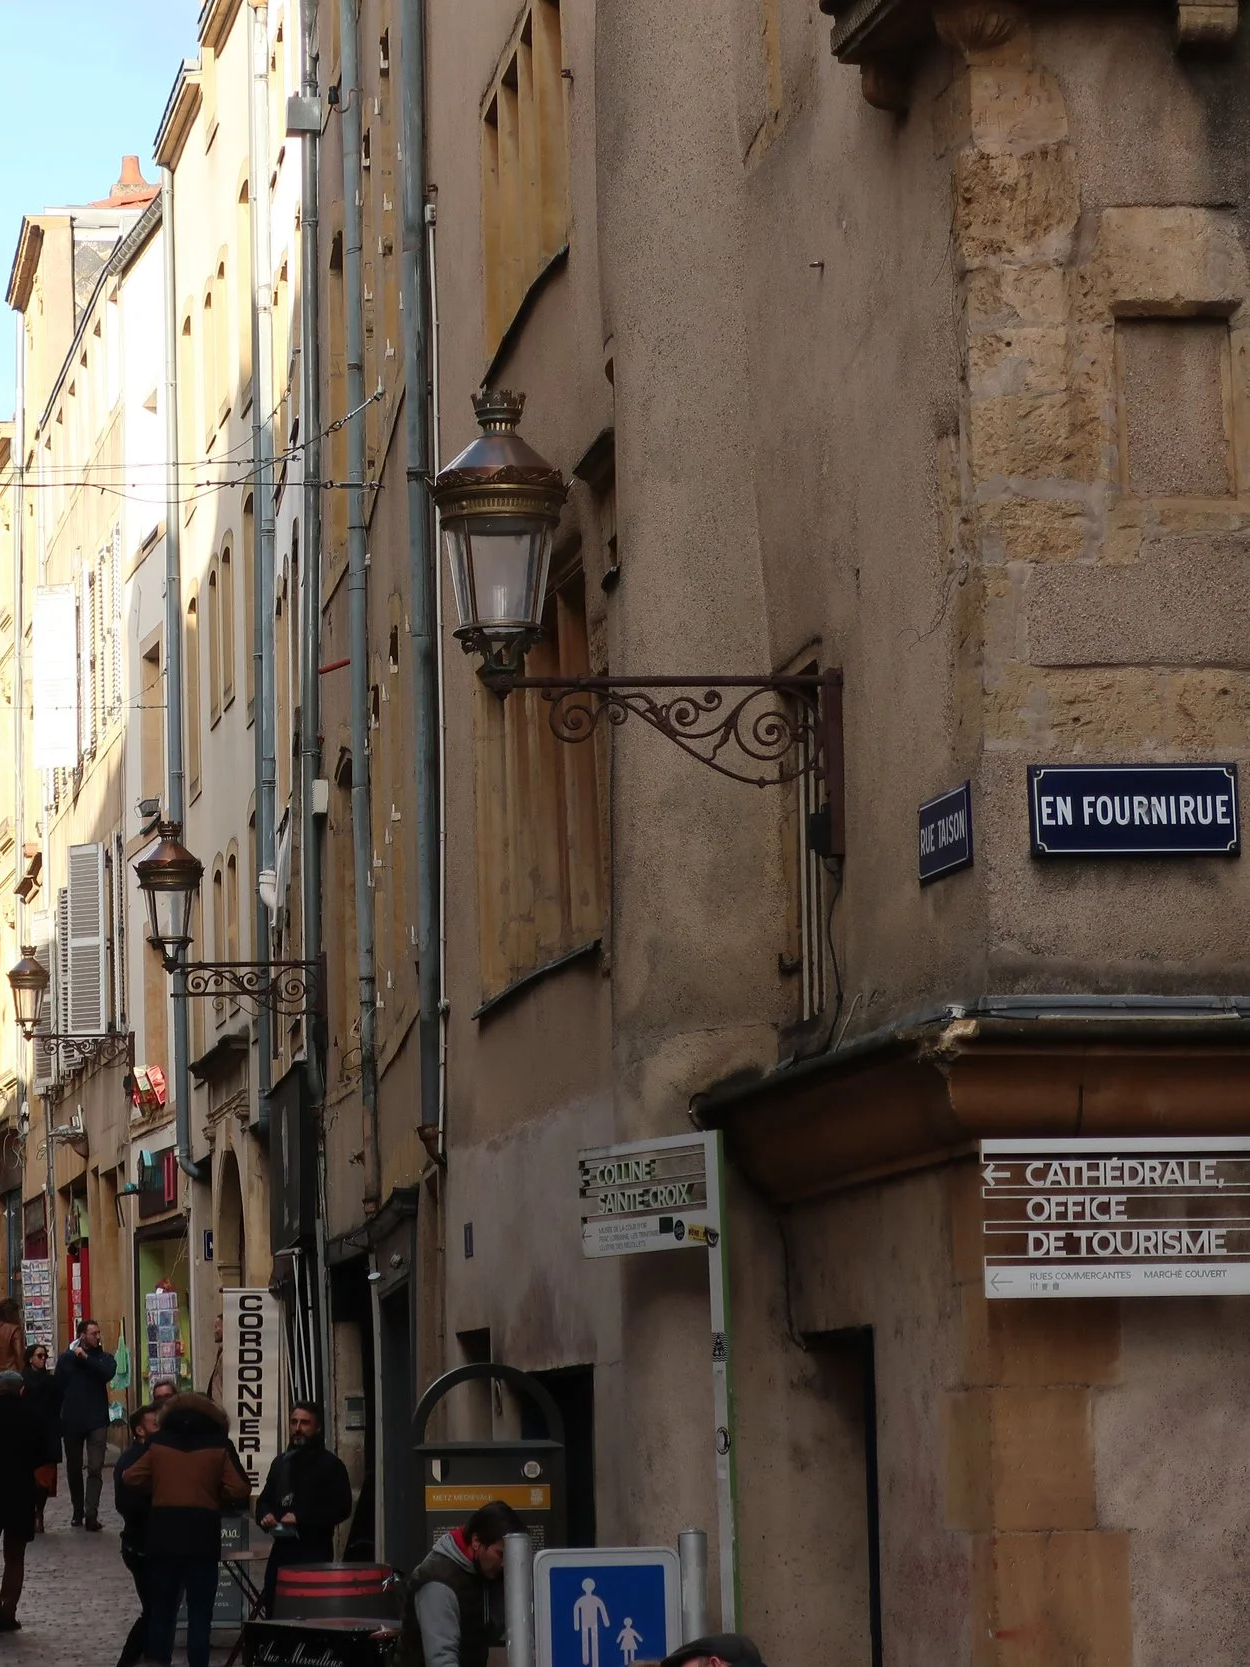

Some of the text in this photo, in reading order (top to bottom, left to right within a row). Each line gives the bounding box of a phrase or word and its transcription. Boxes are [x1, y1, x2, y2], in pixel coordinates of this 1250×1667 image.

[1040, 795, 1231, 826] EN FOURNIRUE
[920, 808, 966, 857] RUE TAISON
[596, 1160, 651, 1185] COLLINE
[1025, 1157, 1225, 1189] CATHÉDRALE,
[599, 1183, 688, 1214] SAINTE-CROIX
[1026, 1196, 1128, 1222] OFFICE
[1027, 1229, 1228, 1257] DE TOURISME
[1030, 1272, 1053, 1281] RUES
[1185, 1269, 1227, 1278] COUVERT
